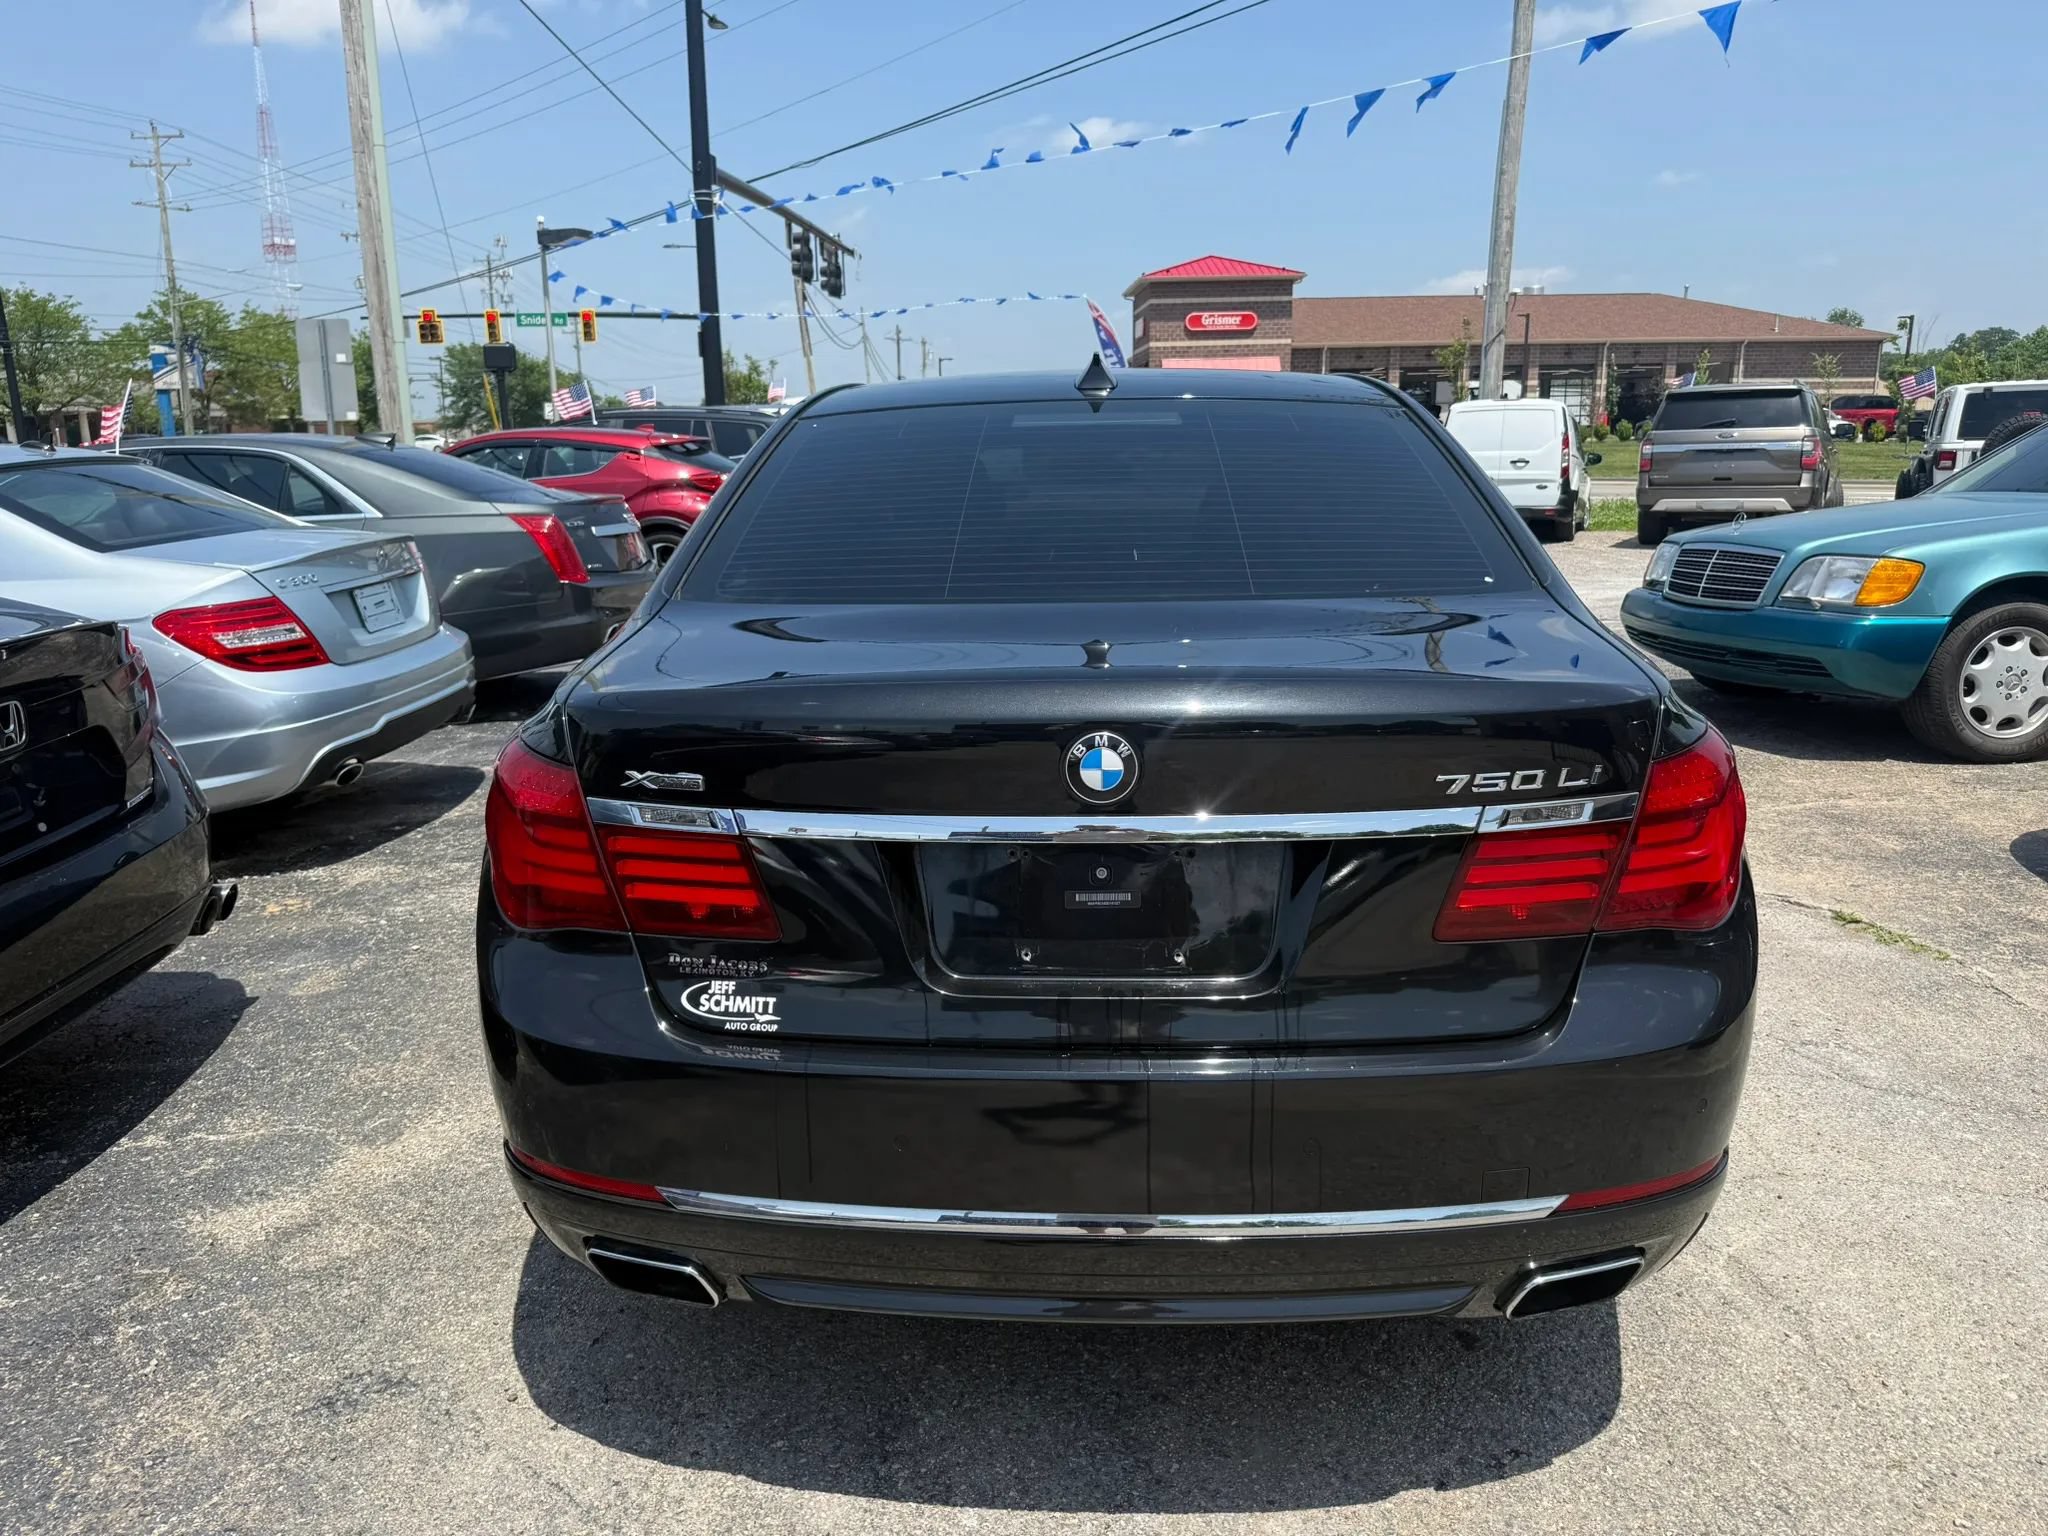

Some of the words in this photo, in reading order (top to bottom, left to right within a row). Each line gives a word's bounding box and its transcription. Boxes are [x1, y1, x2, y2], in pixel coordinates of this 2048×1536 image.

[519, 315, 548, 325] Snide
[554, 317, 564, 325] Rd
[1201, 314, 1242, 325] Grismer
[288, 573, 319, 587] 300
[1072, 734, 1132, 759] BMW
[1435, 769, 1547, 795] 750
[1557, 764, 1604, 788] Li
[708, 980, 736, 994] JEFF
[699, 994, 777, 1014] SCHMITT
[724, 1021, 748, 1031] AUTO
[749, 1022, 779, 1032] GROUP
